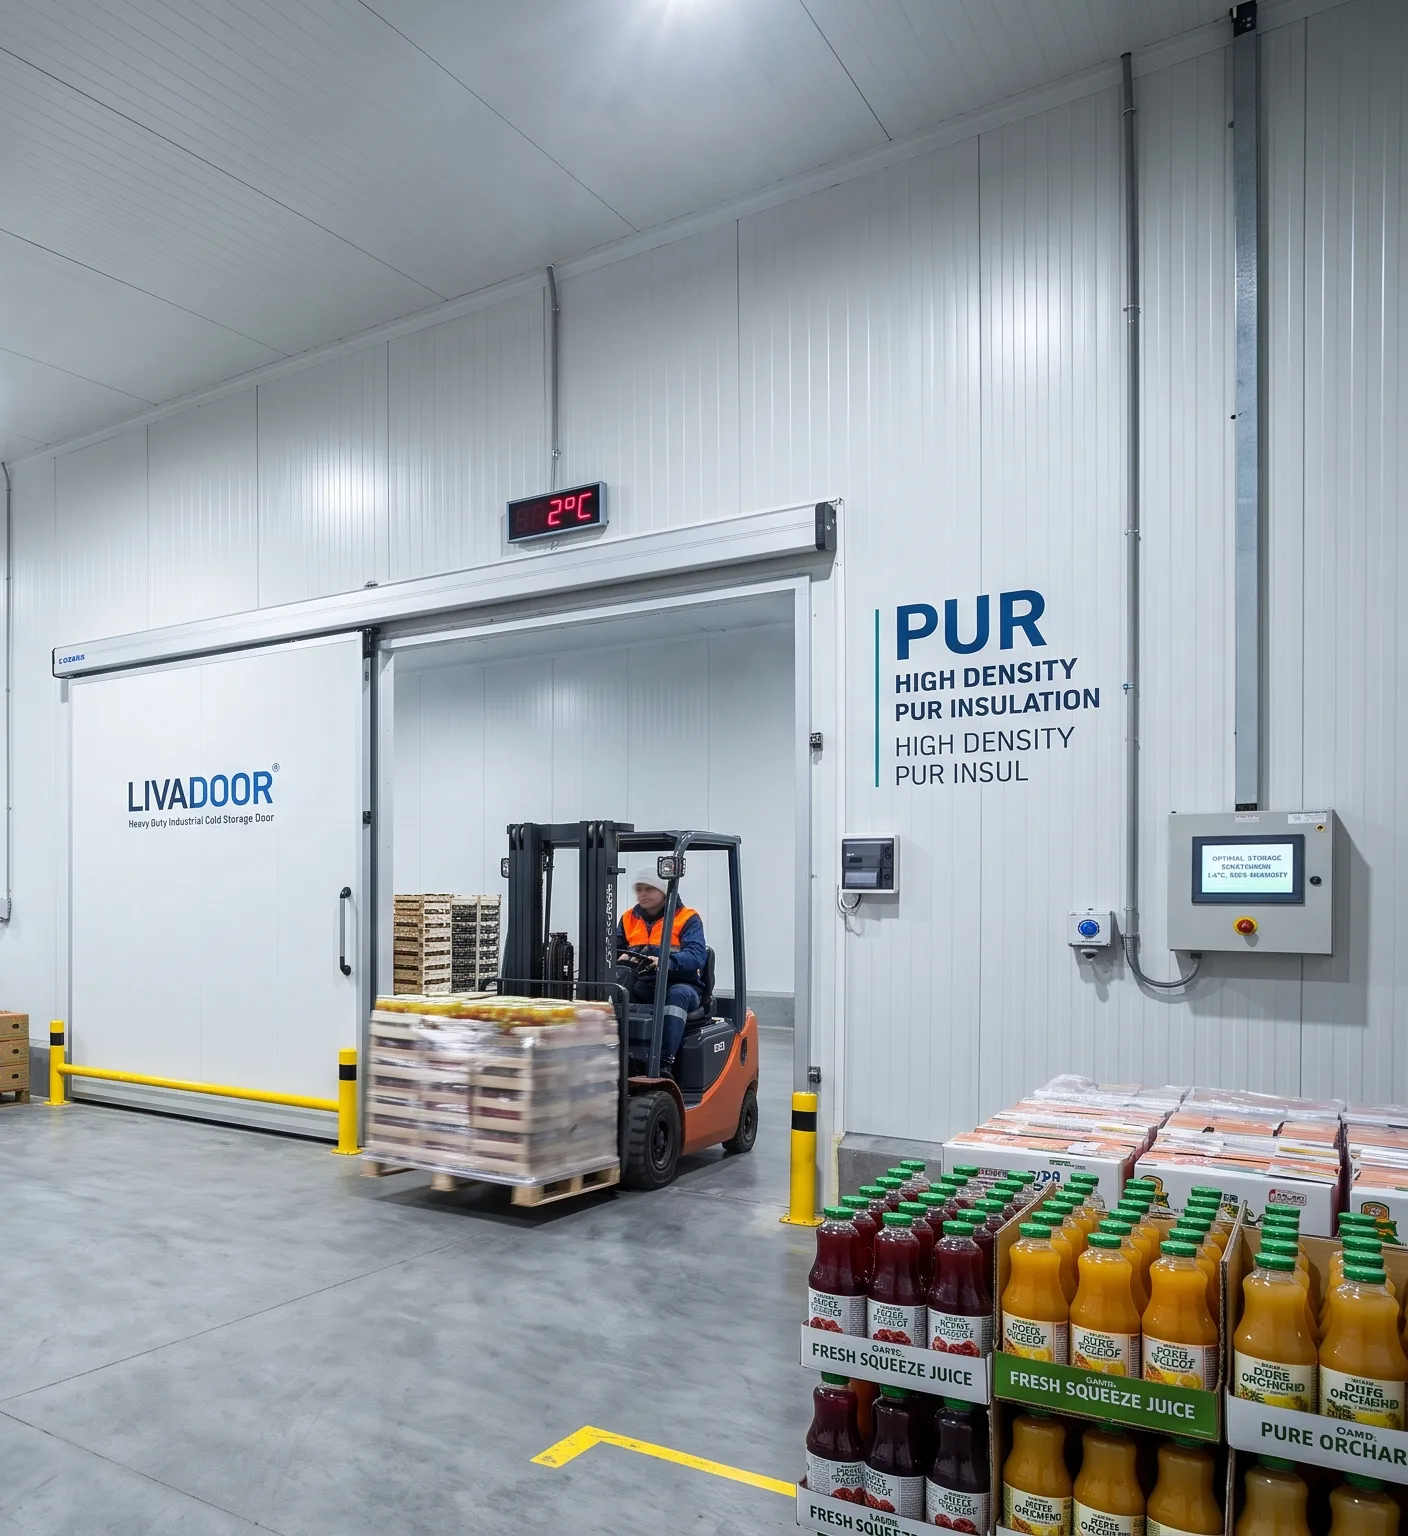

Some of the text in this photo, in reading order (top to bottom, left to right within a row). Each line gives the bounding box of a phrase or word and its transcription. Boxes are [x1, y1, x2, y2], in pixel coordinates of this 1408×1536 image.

[896, 589, 1048, 661] PUR
[895, 657, 1078, 693] HIGH DENSITY
[895, 687, 1100, 722] PUR INSULATION
[896, 726, 1075, 757] HIGH DENSITY
[896, 760, 1029, 786] PUR INSUL
[128, 819, 150, 830] Heavy
[168, 816, 204, 826] Industrial
[205, 815, 222, 825] Cold
[223, 814, 253, 825] Storage
[255, 813, 275, 823] Door
[812, 1342, 973, 1386] FRESH SQUEEZE JUICE
[1010, 1370, 1196, 1420] FRESH SQUEEZE JUICE
[1261, 1421, 1314, 1447] PURE
[810, 1504, 853, 1529] FRESH
